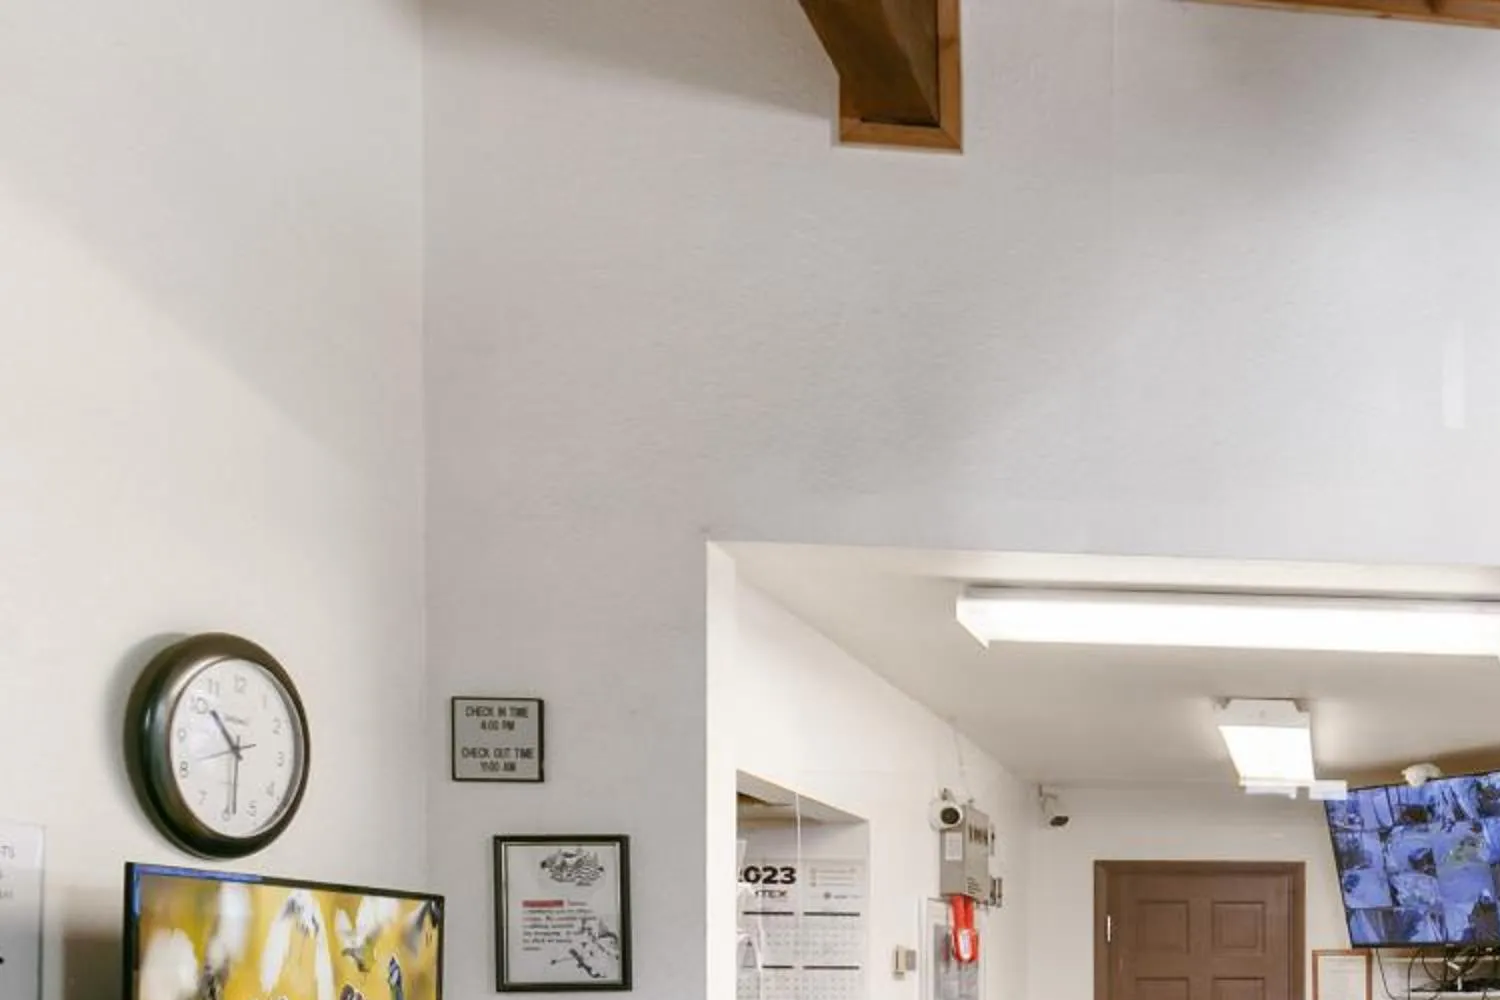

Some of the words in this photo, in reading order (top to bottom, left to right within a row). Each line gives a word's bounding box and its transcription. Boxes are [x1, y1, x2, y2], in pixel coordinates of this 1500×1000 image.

[464, 705, 493, 717] CHECK
[509, 706, 529, 718] TIME
[461, 747, 489, 758] CHECK
[493, 747, 512, 758] OUT
[514, 747, 534, 759] TIME
[739, 866, 797, 885] 023
